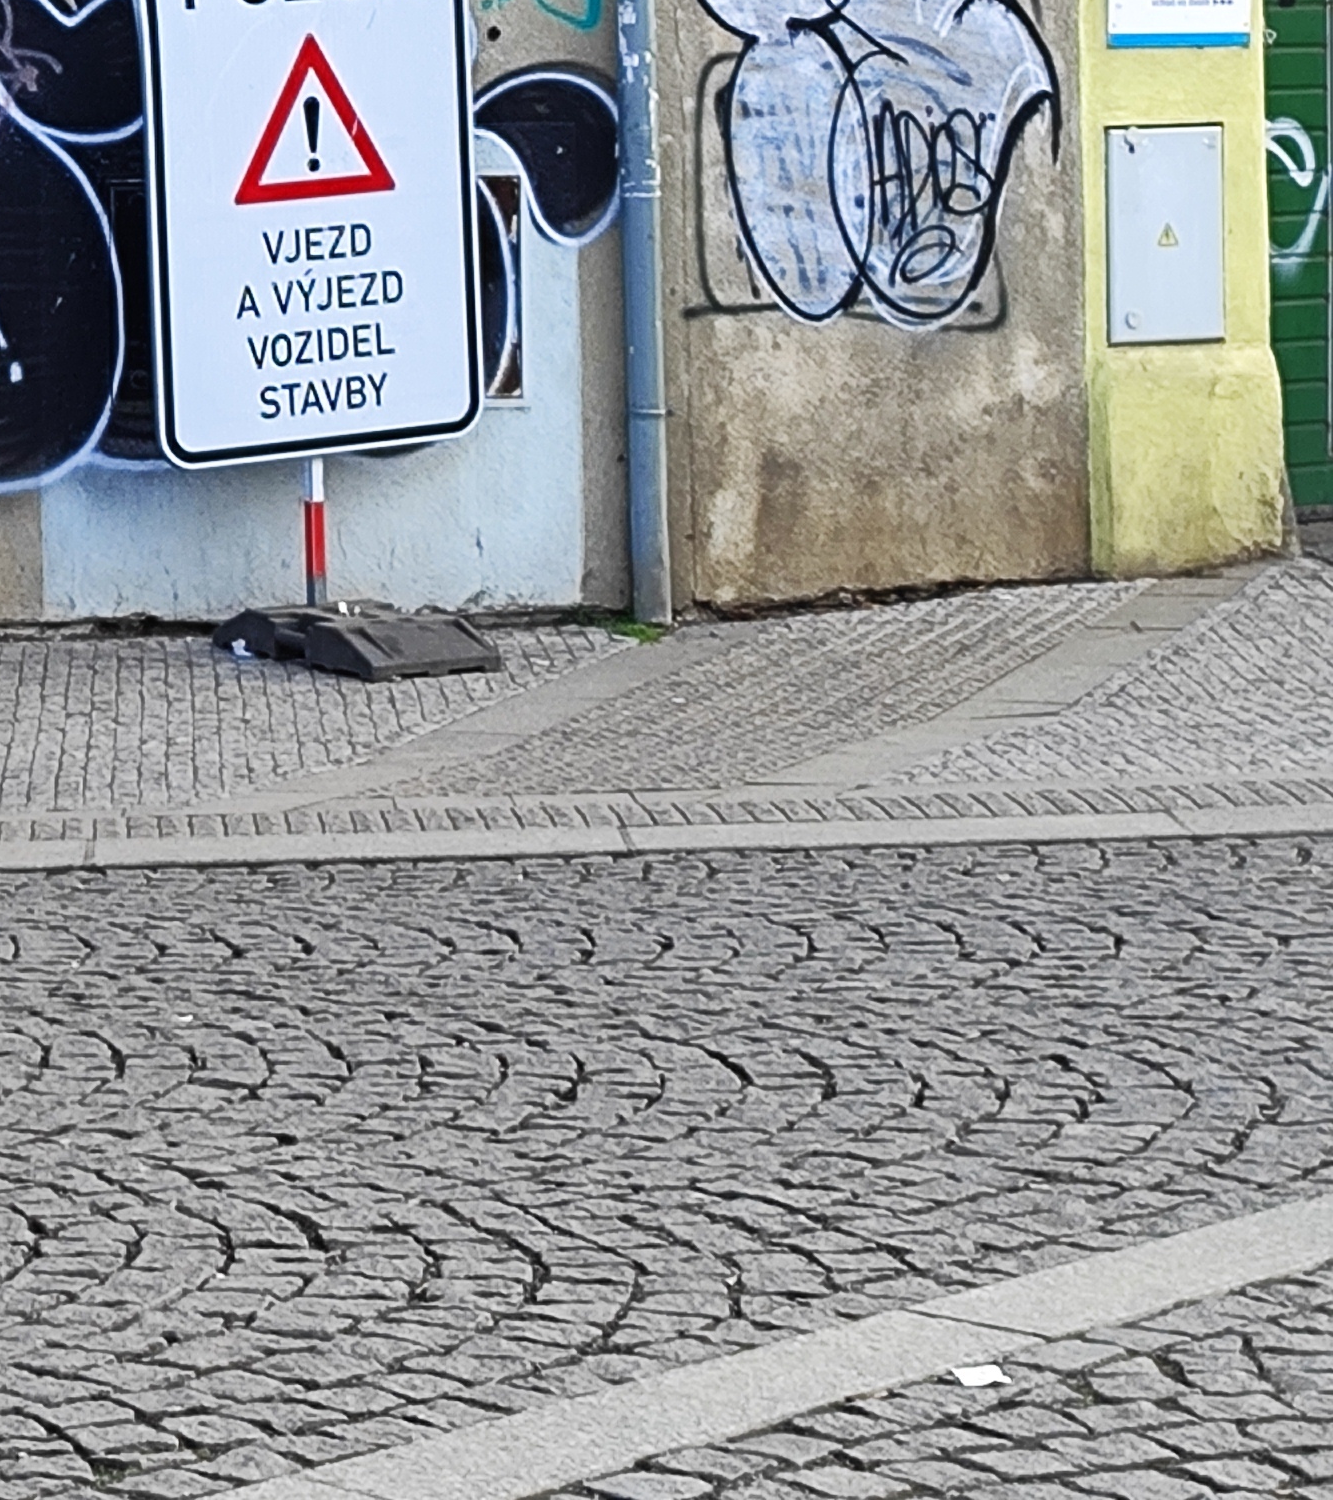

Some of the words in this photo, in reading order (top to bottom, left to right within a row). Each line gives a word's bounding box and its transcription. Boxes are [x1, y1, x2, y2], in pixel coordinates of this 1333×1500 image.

[262, 222, 372, 265] VJEZD
[236, 286, 261, 320] A
[273, 268, 404, 312] VÝJEZD
[247, 323, 396, 370] VOZIDEL
[259, 372, 389, 420] STAVBY
